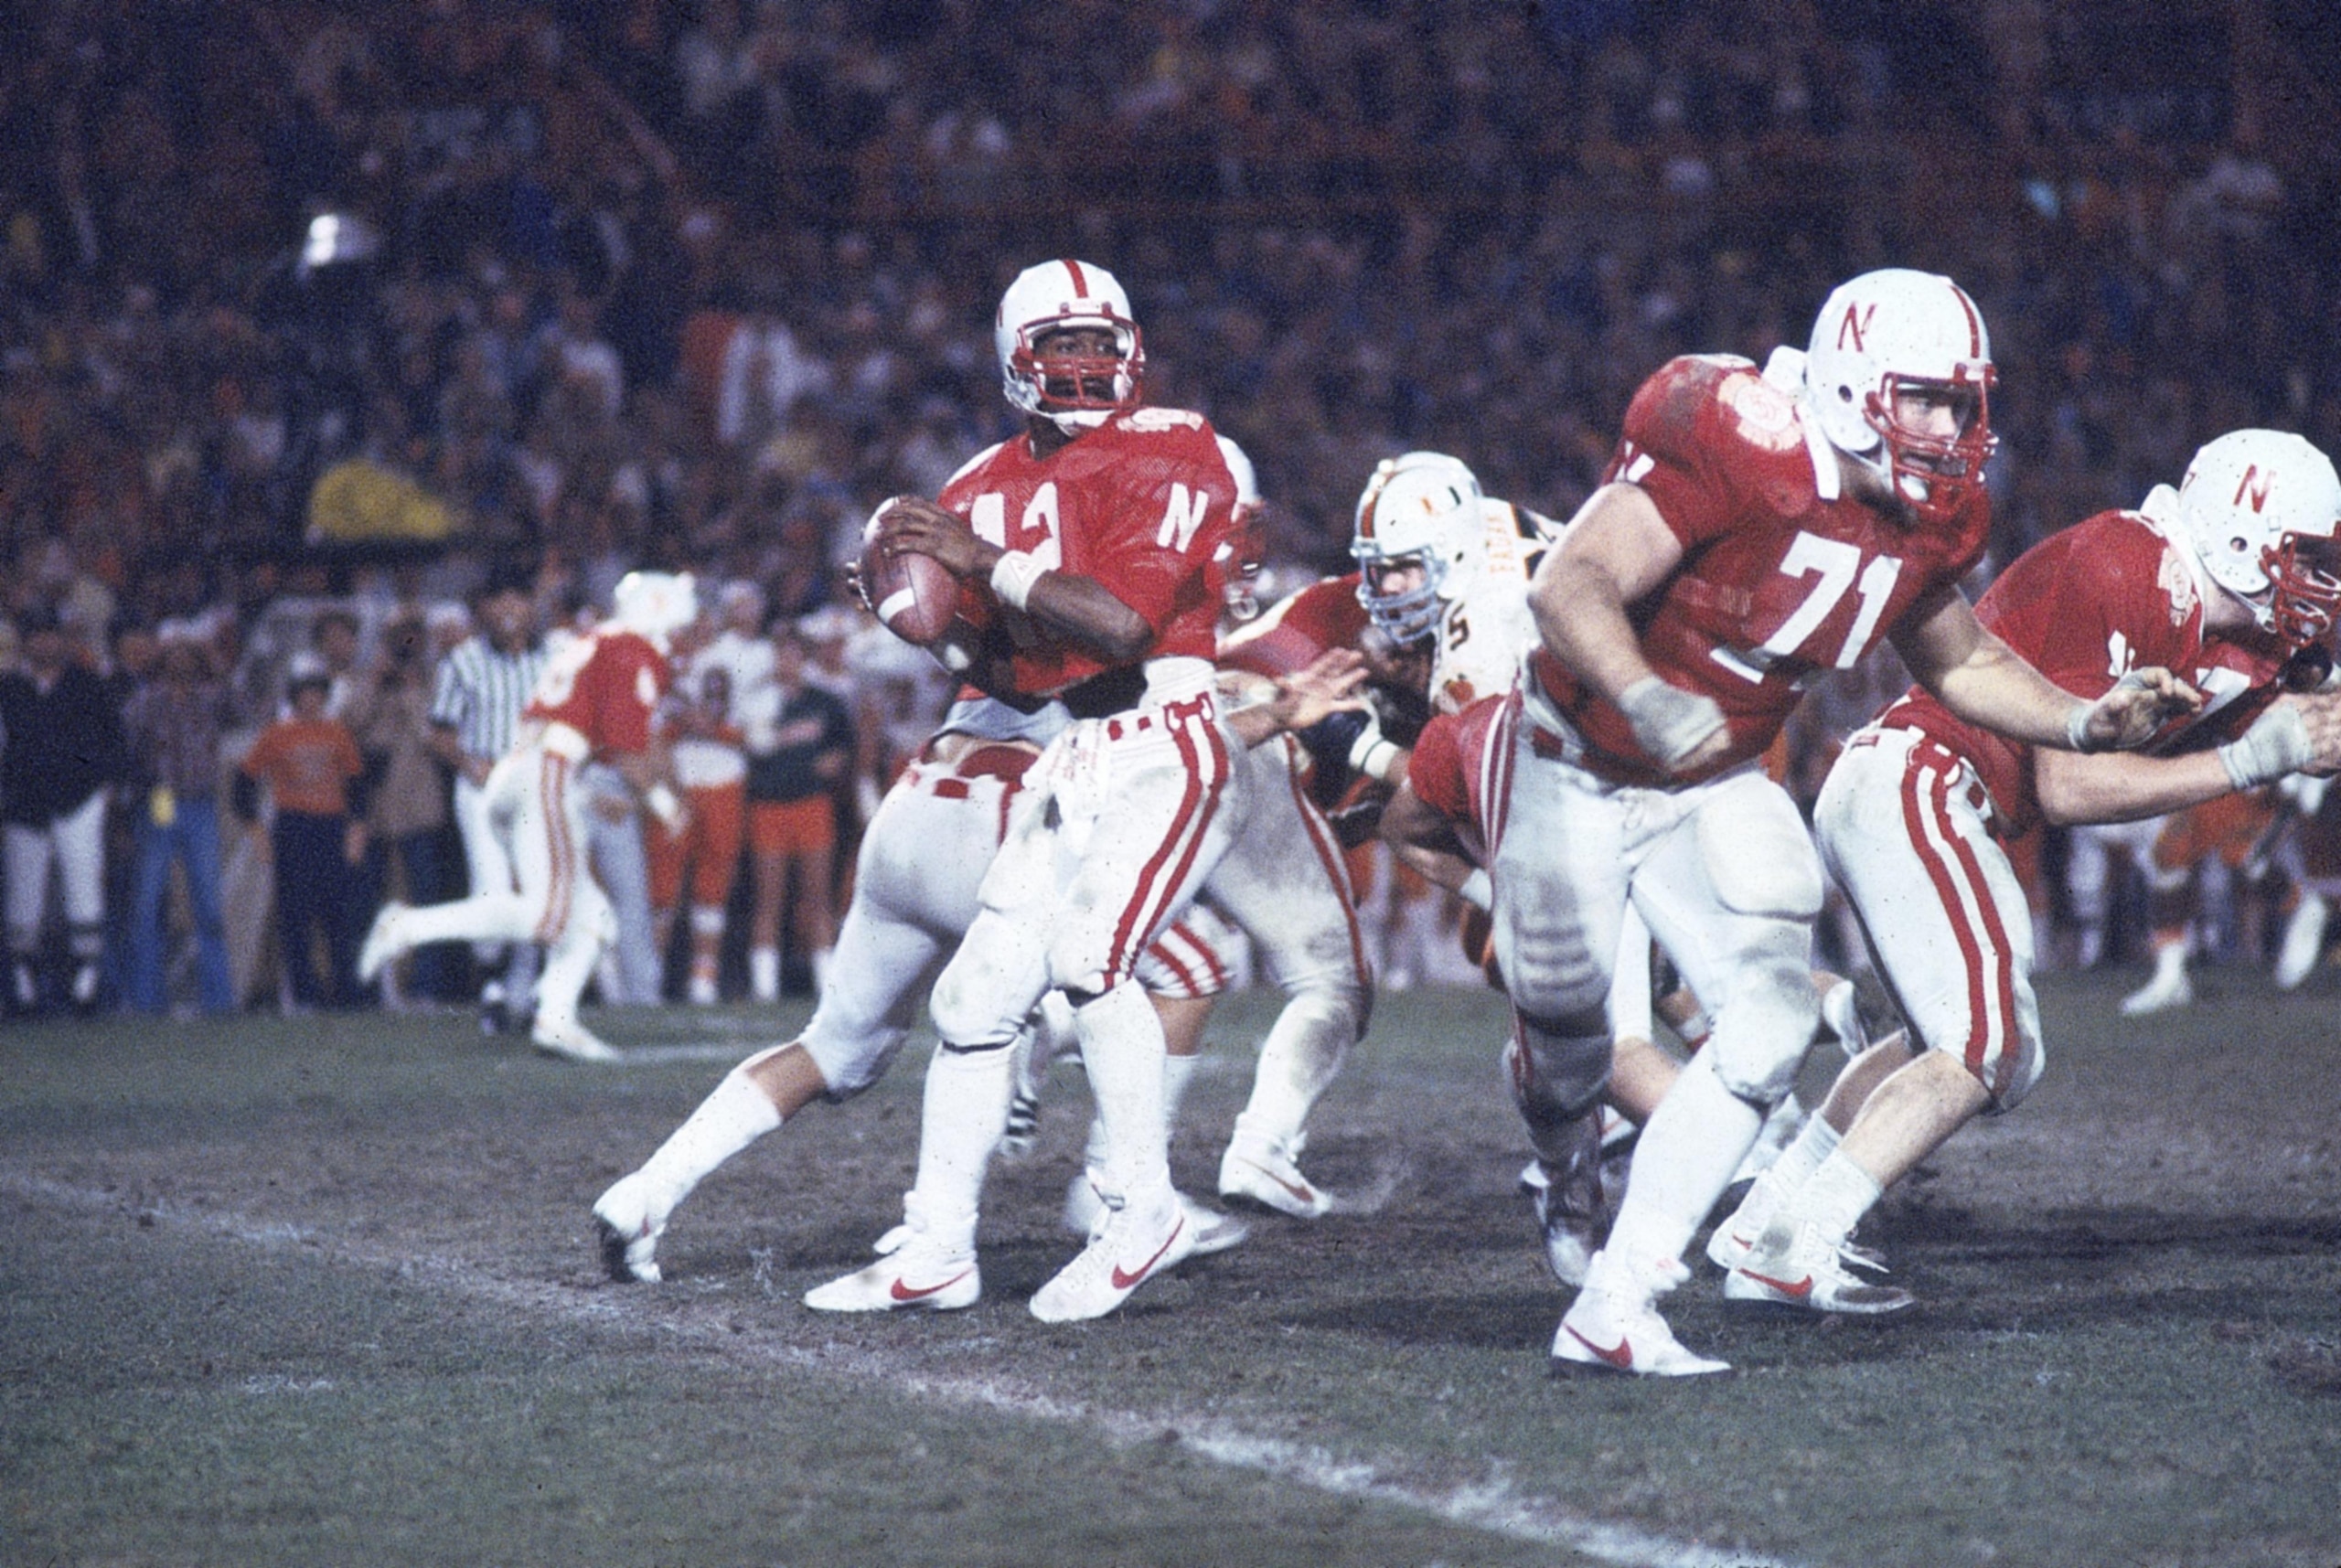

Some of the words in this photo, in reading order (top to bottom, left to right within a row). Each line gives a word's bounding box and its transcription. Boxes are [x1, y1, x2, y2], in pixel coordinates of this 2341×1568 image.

[1837, 302, 1877, 352] N
[1156, 481, 1209, 554] N
[2233, 464, 2277, 514] N
[1762, 530, 1903, 668] 71
